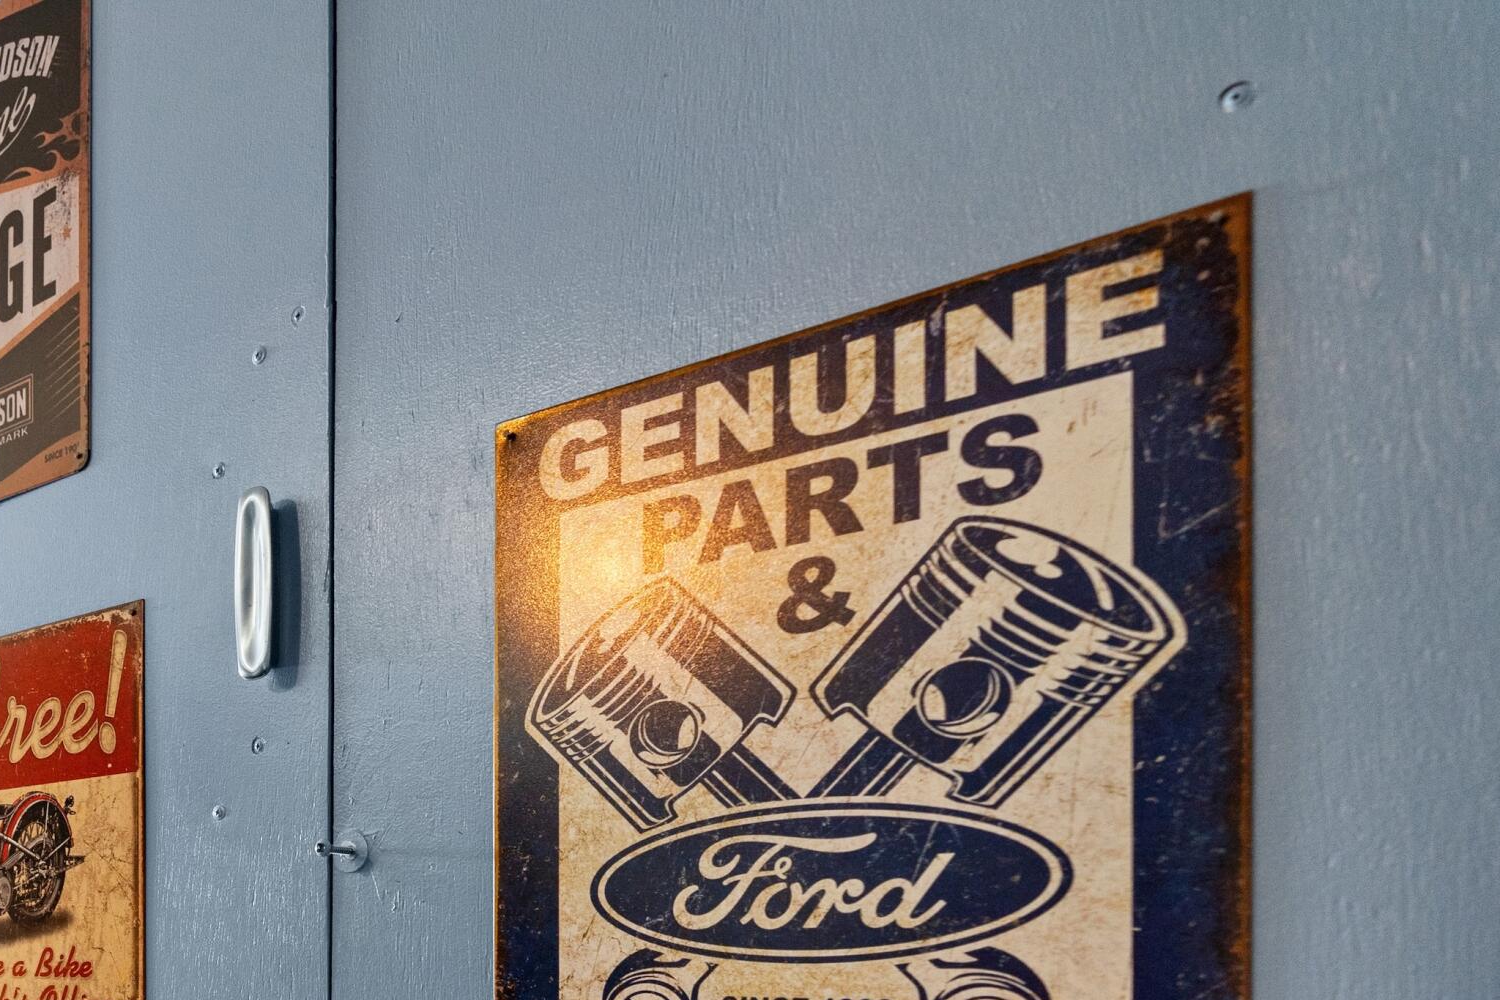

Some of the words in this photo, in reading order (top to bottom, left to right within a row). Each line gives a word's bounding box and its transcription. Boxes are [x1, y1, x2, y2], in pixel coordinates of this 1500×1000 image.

[539, 247, 1167, 502] GENUINE
[640, 413, 1043, 576] PARTS
[776, 556, 856, 634] &
[672, 832, 955, 931] Ford
[12, 960, 27, 977] a
[35, 946, 94, 979] Bike
